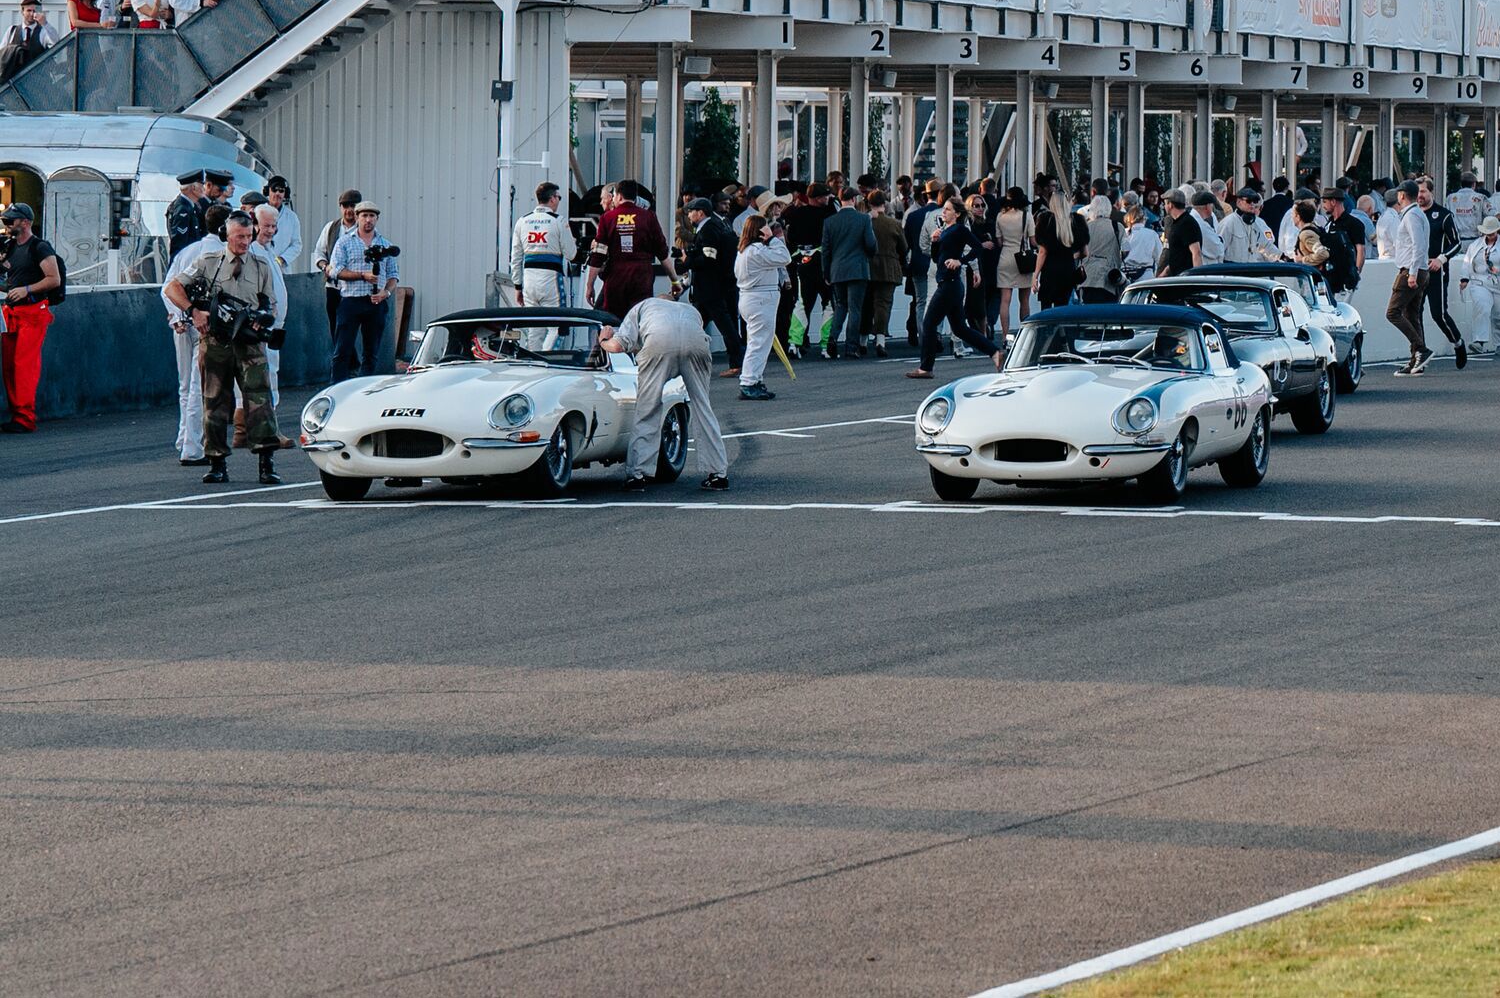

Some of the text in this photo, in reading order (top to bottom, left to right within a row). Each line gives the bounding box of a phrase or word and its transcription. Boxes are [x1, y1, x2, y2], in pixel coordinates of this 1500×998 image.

[782, 21, 789, 44] 1
[870, 29, 885, 52] 2
[959, 37, 973, 59] 3
[1041, 44, 1055, 65] 4
[1118, 51, 1131, 72] 5
[1190, 58, 1204, 77] 6
[1290, 66, 1303, 85] 7
[1352, 71, 1365, 89] 8
[1412, 76, 1424, 94] 9
[1456, 82, 1478, 99] 10
[616, 213, 637, 225] DK
[527, 231, 548, 244] DK
[963, 384, 1028, 399] 66
[384, 408, 421, 417] 1 PKL
[1232, 386, 1248, 430] 66
